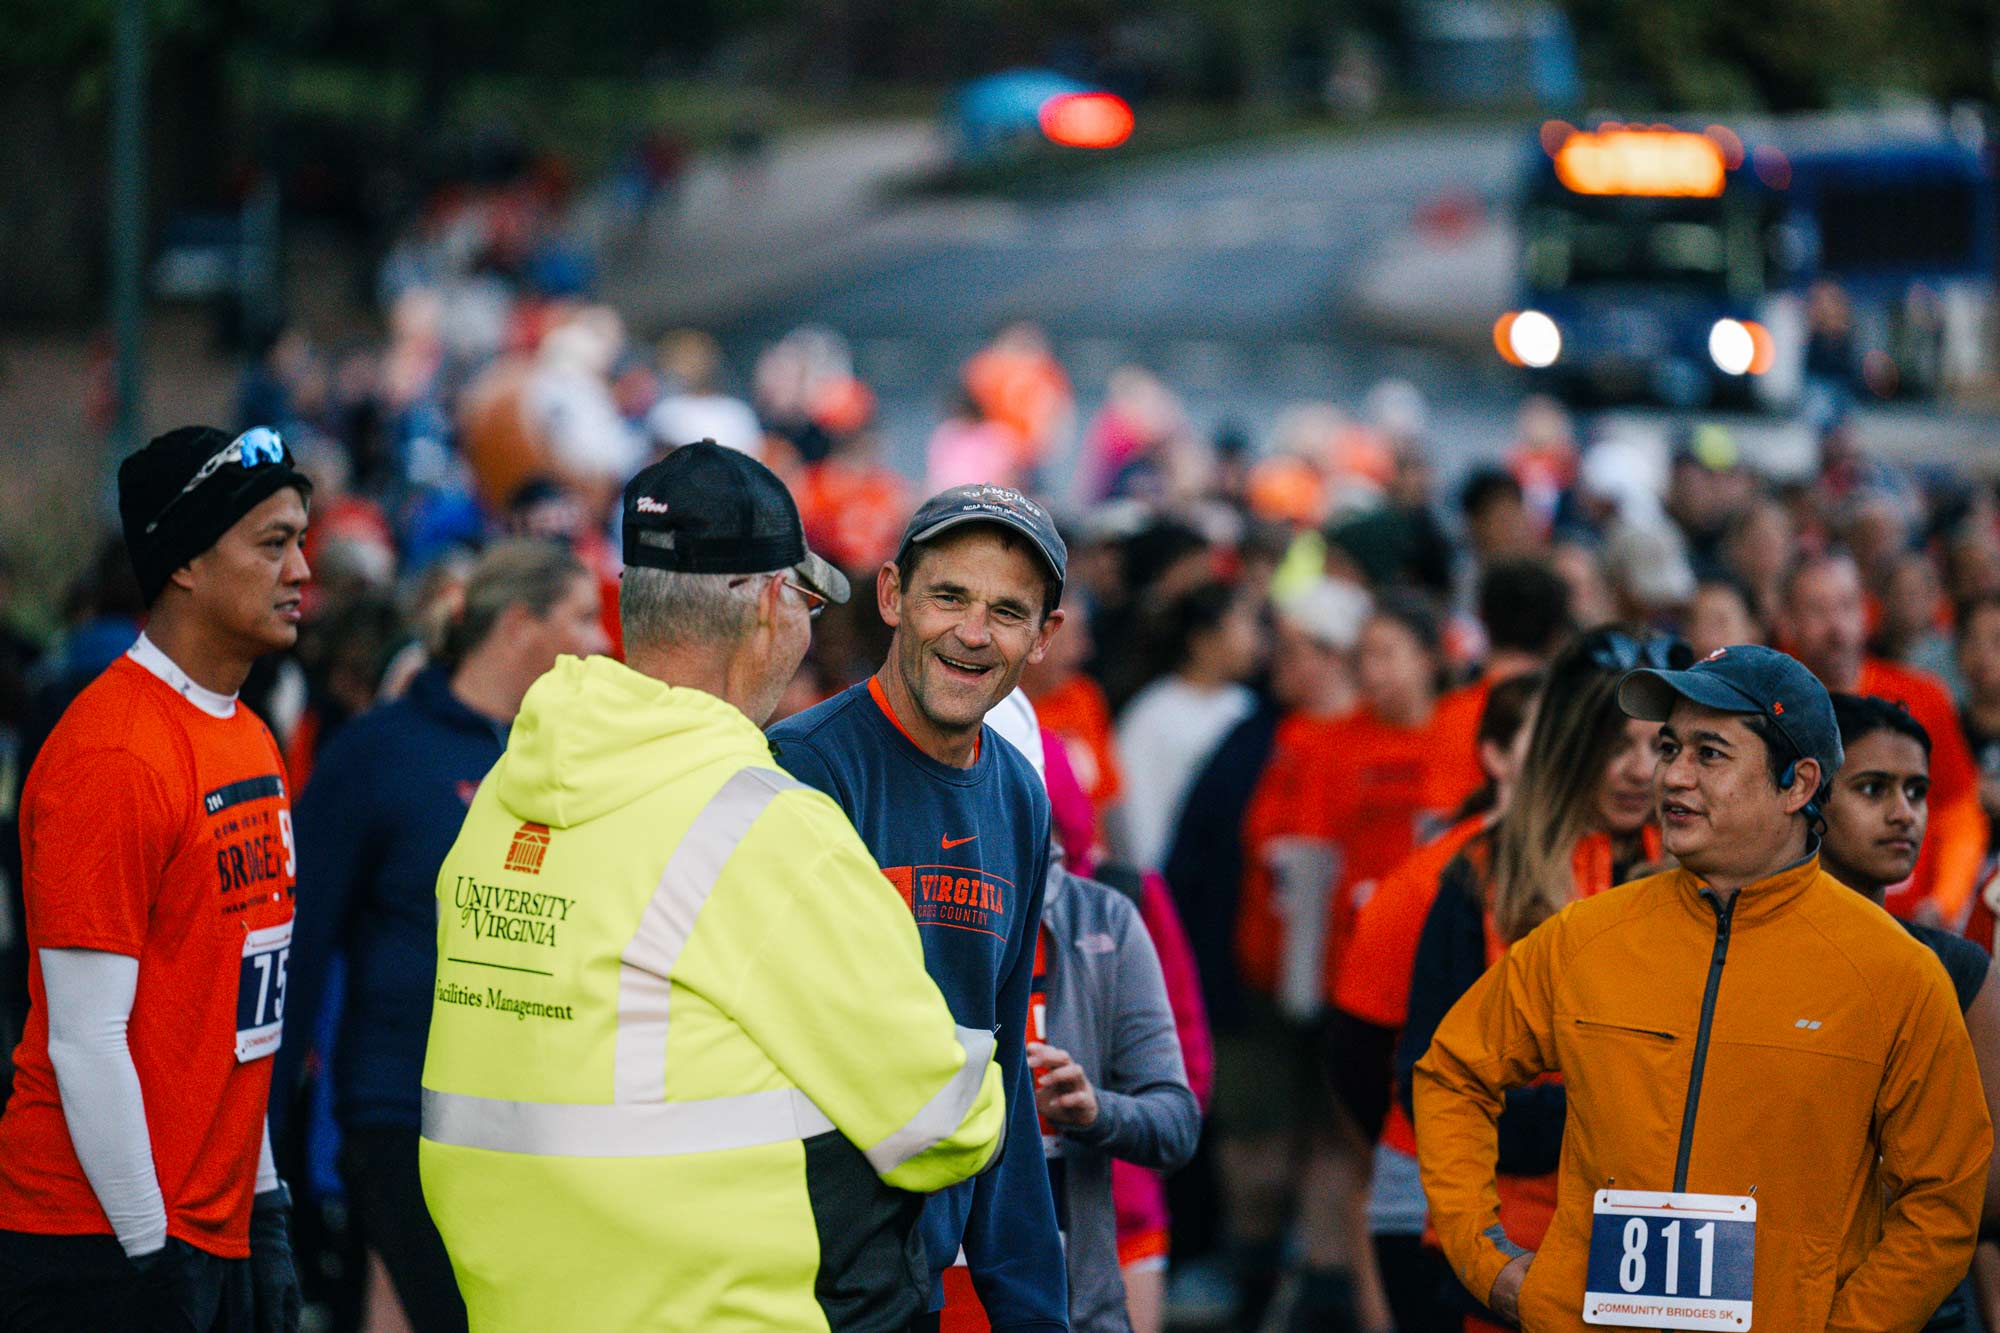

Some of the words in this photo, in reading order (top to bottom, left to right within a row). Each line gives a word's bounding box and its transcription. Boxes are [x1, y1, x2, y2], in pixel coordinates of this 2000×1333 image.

[963, 487, 1041, 517] CHAMPIONS
[963, 503, 981, 512] NCAA
[455, 875, 577, 921] UNIVERSITY
[919, 874, 1004, 915] VIRGINIA
[469, 907, 557, 948] VIRGINIA
[939, 904, 989, 927] COUNTRY
[254, 947, 290, 1026] 75
[486, 987, 574, 1021] Management
[1618, 1217, 1715, 1297] 811
[1597, 1302, 1663, 1317] COMMUNITY
[1666, 1306, 1717, 1320] BRIDGES
[1719, 1309, 1734, 1320] 5K
